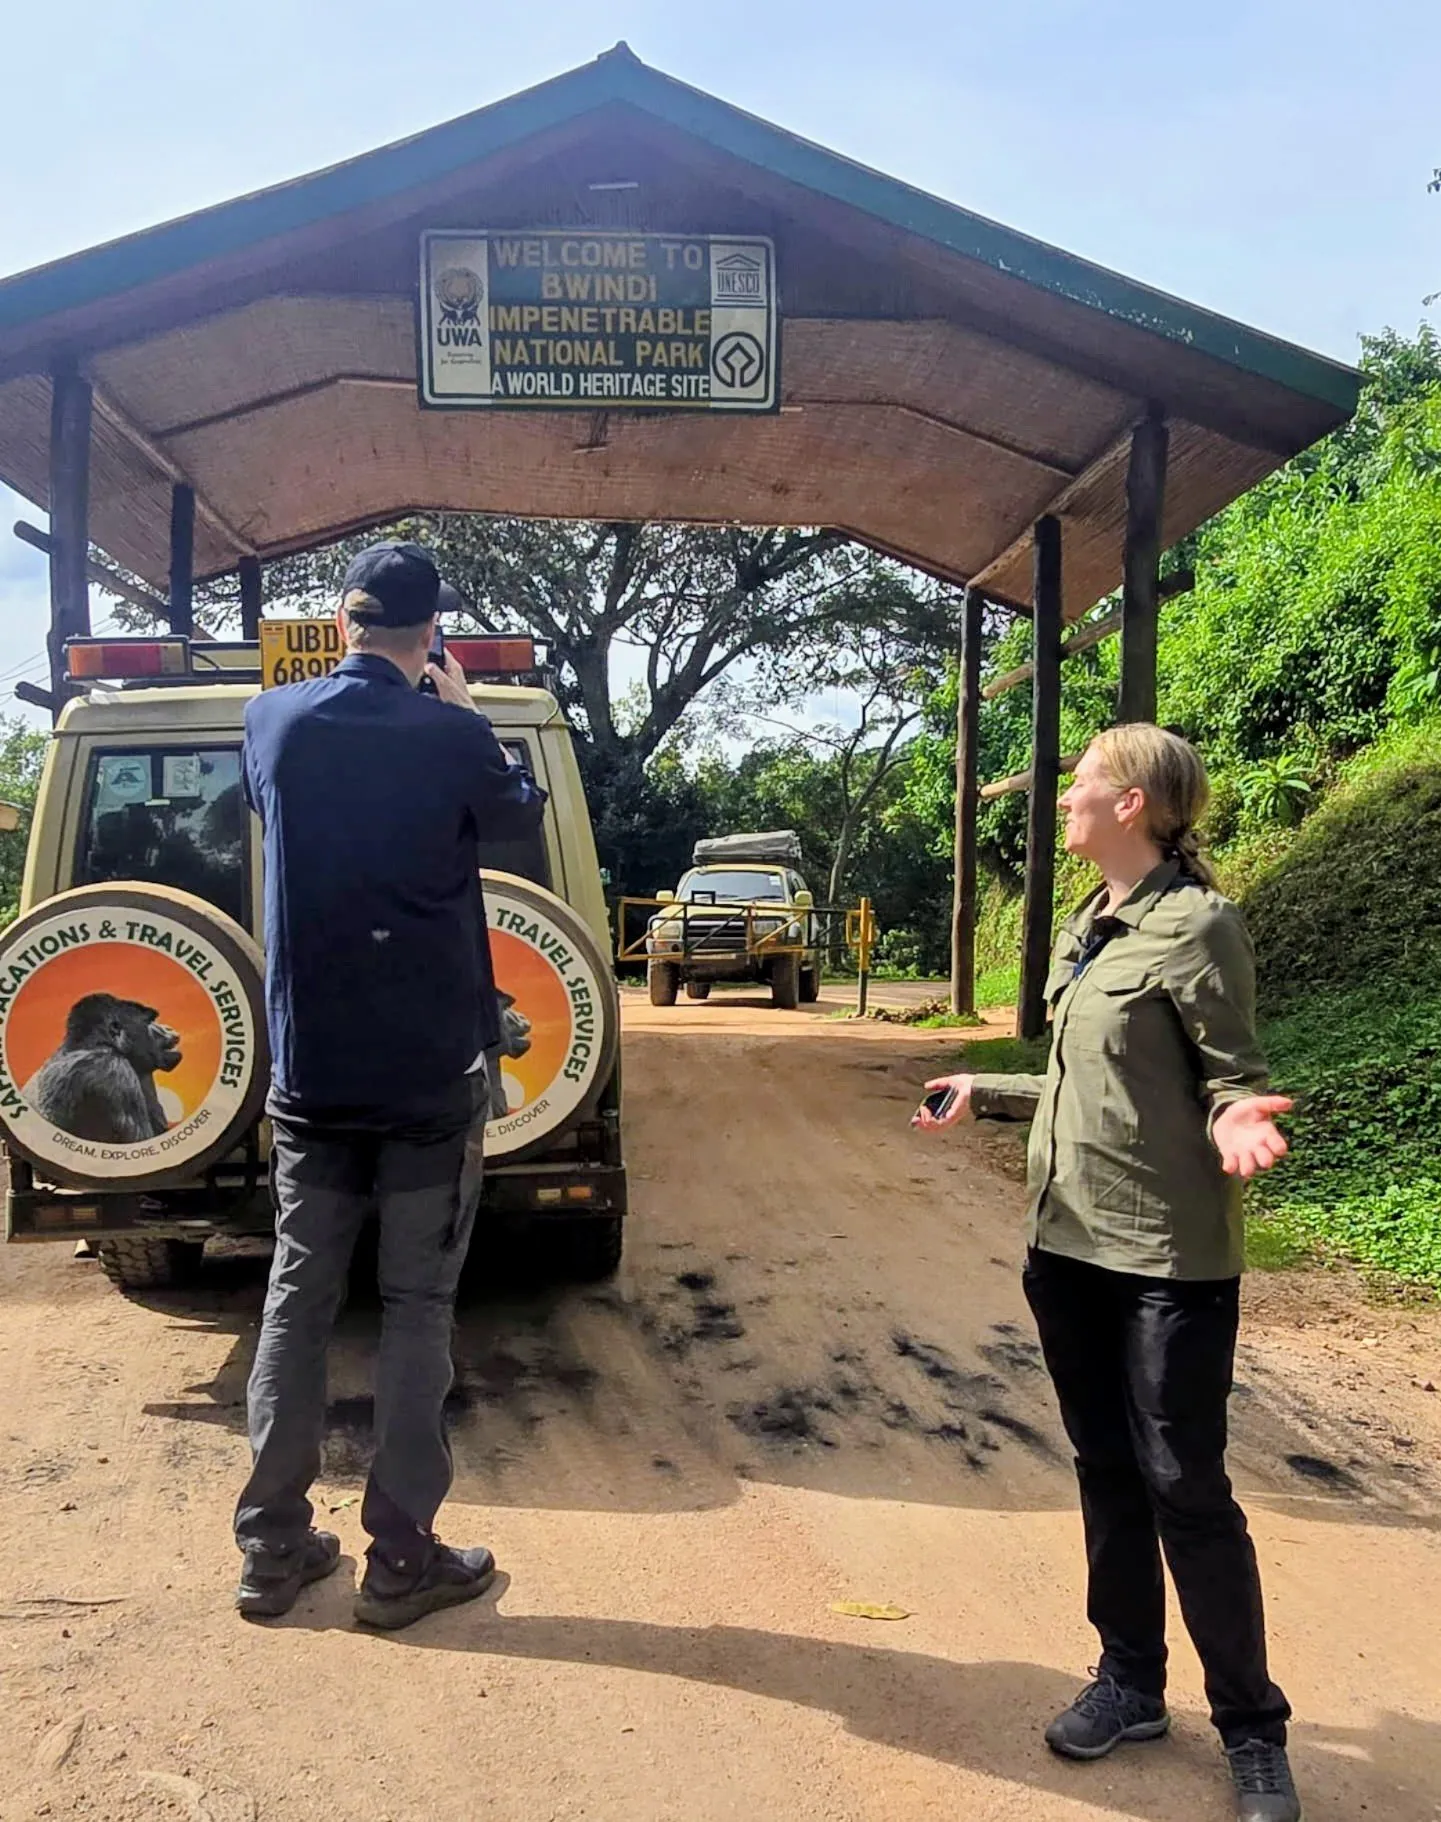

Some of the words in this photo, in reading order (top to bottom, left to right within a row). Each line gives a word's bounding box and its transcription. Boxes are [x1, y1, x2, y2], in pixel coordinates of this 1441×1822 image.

[493, 239, 645, 269] WELCOME
[660, 242, 703, 270] TO
[542, 273, 657, 302] BWINDI
[717, 271, 760, 293] UNESCO
[490, 305, 711, 335] IMPENETRABLE
[437, 327, 482, 347] UWA
[494, 339, 624, 367] NATIONAL
[636, 341, 704, 368] PARK
[492, 372, 505, 395] A
[506, 371, 574, 396] WORLD
[580, 372, 666, 397] HERITAGE
[671, 374, 710, 398] SITE
[286, 624, 339, 652] UBD
[0, 923, 91, 1025] ACATIONS
[98, 920, 117, 939] &
[126, 921, 214, 981] TRAVEL
[210, 980, 246, 1088] SERVICES
[497, 908, 574, 975] TRAVEL
[563, 977, 594, 1083] SERVICES
[160, 1108, 212, 1151] DISCOVER
[497, 1099, 551, 1135] DISCOVER
